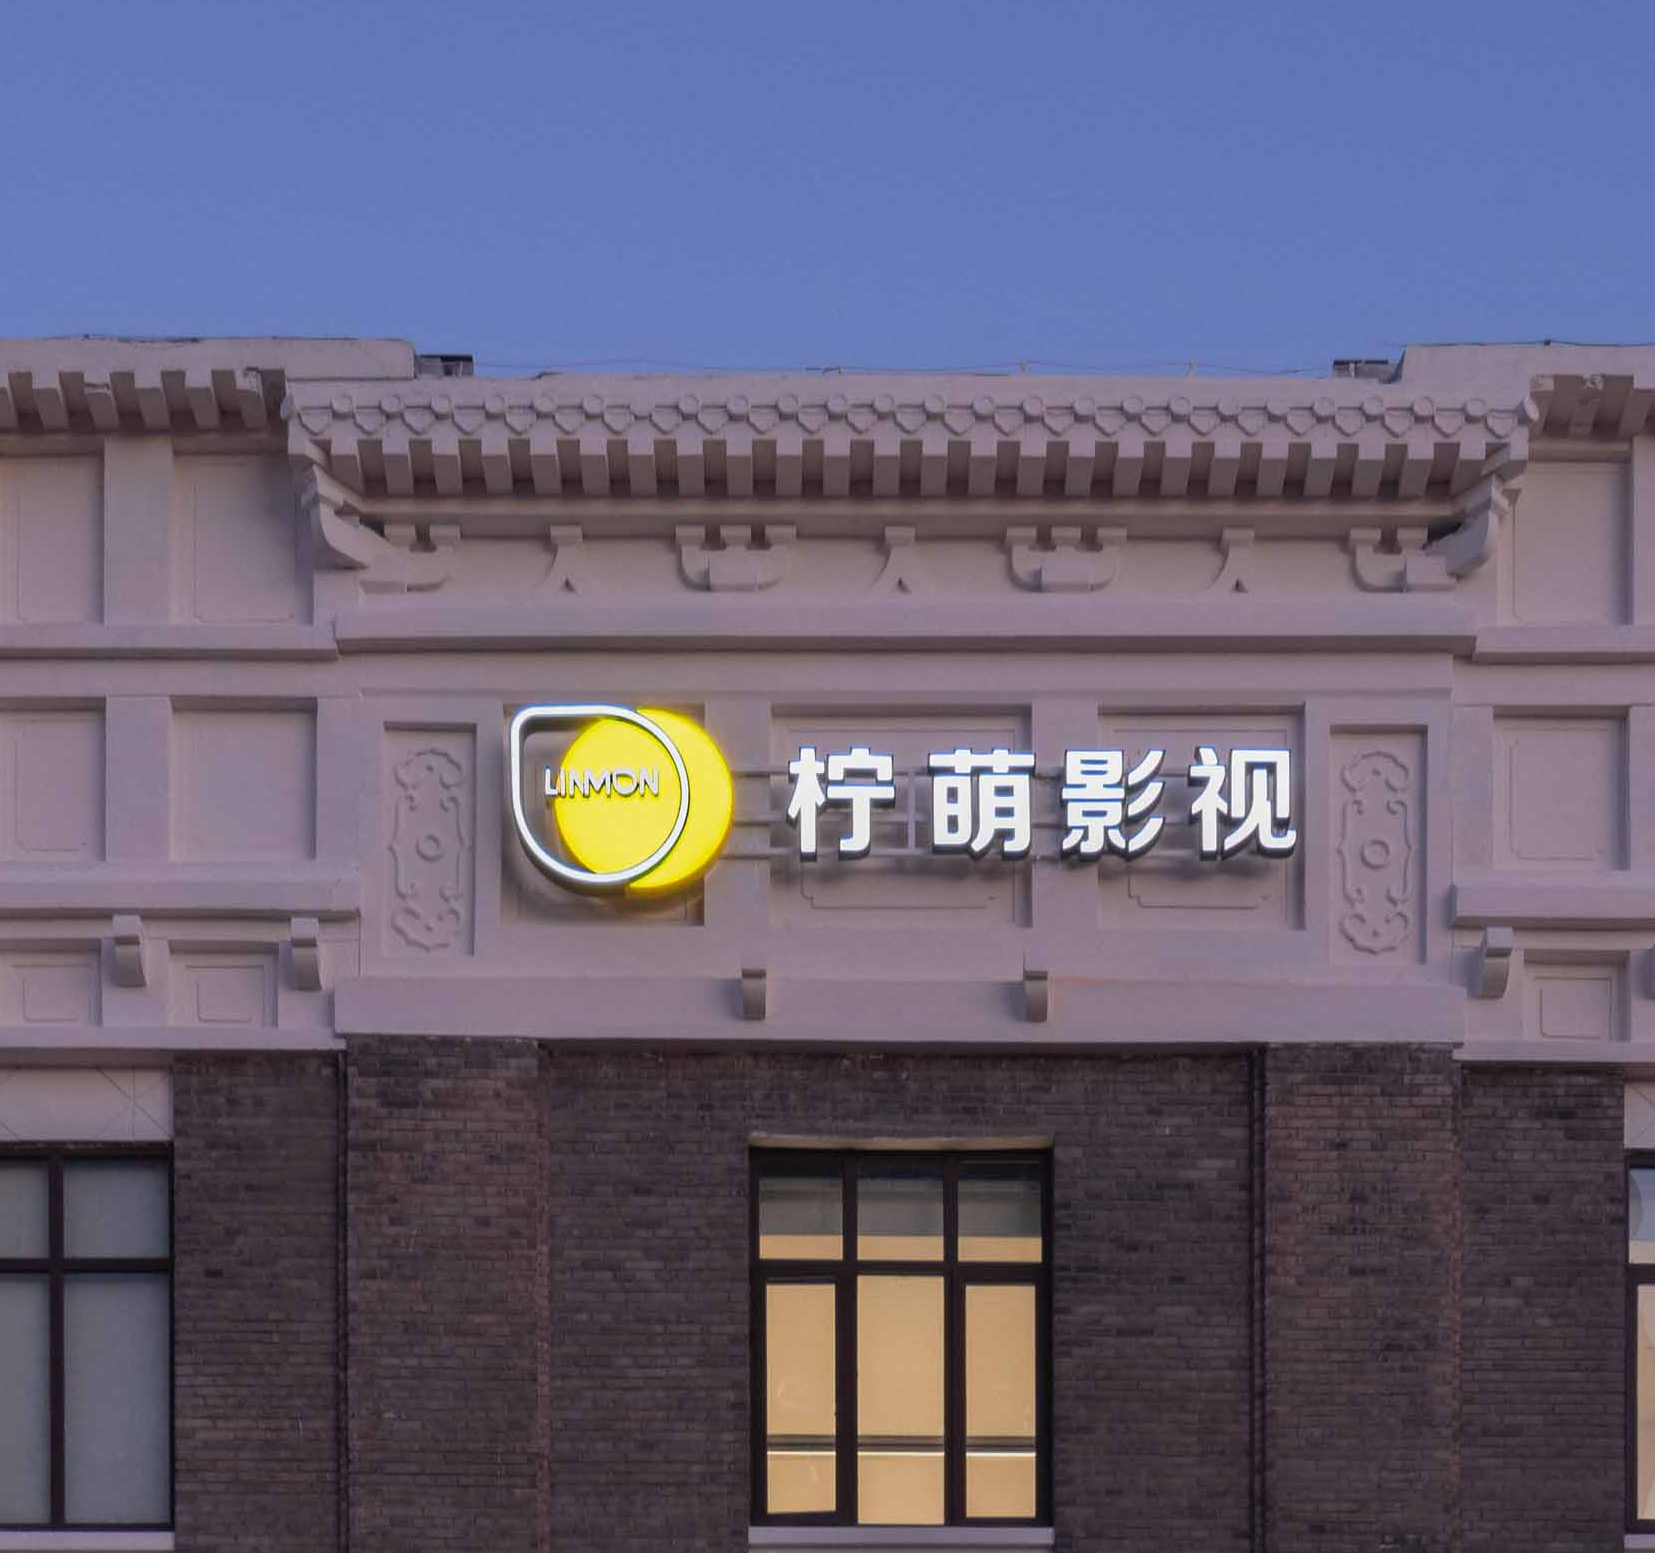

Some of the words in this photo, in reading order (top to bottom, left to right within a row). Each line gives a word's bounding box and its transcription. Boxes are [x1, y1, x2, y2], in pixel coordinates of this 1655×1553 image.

[544, 764, 659, 799] LINMON
[787, 745, 1300, 861] 柠萌影视
